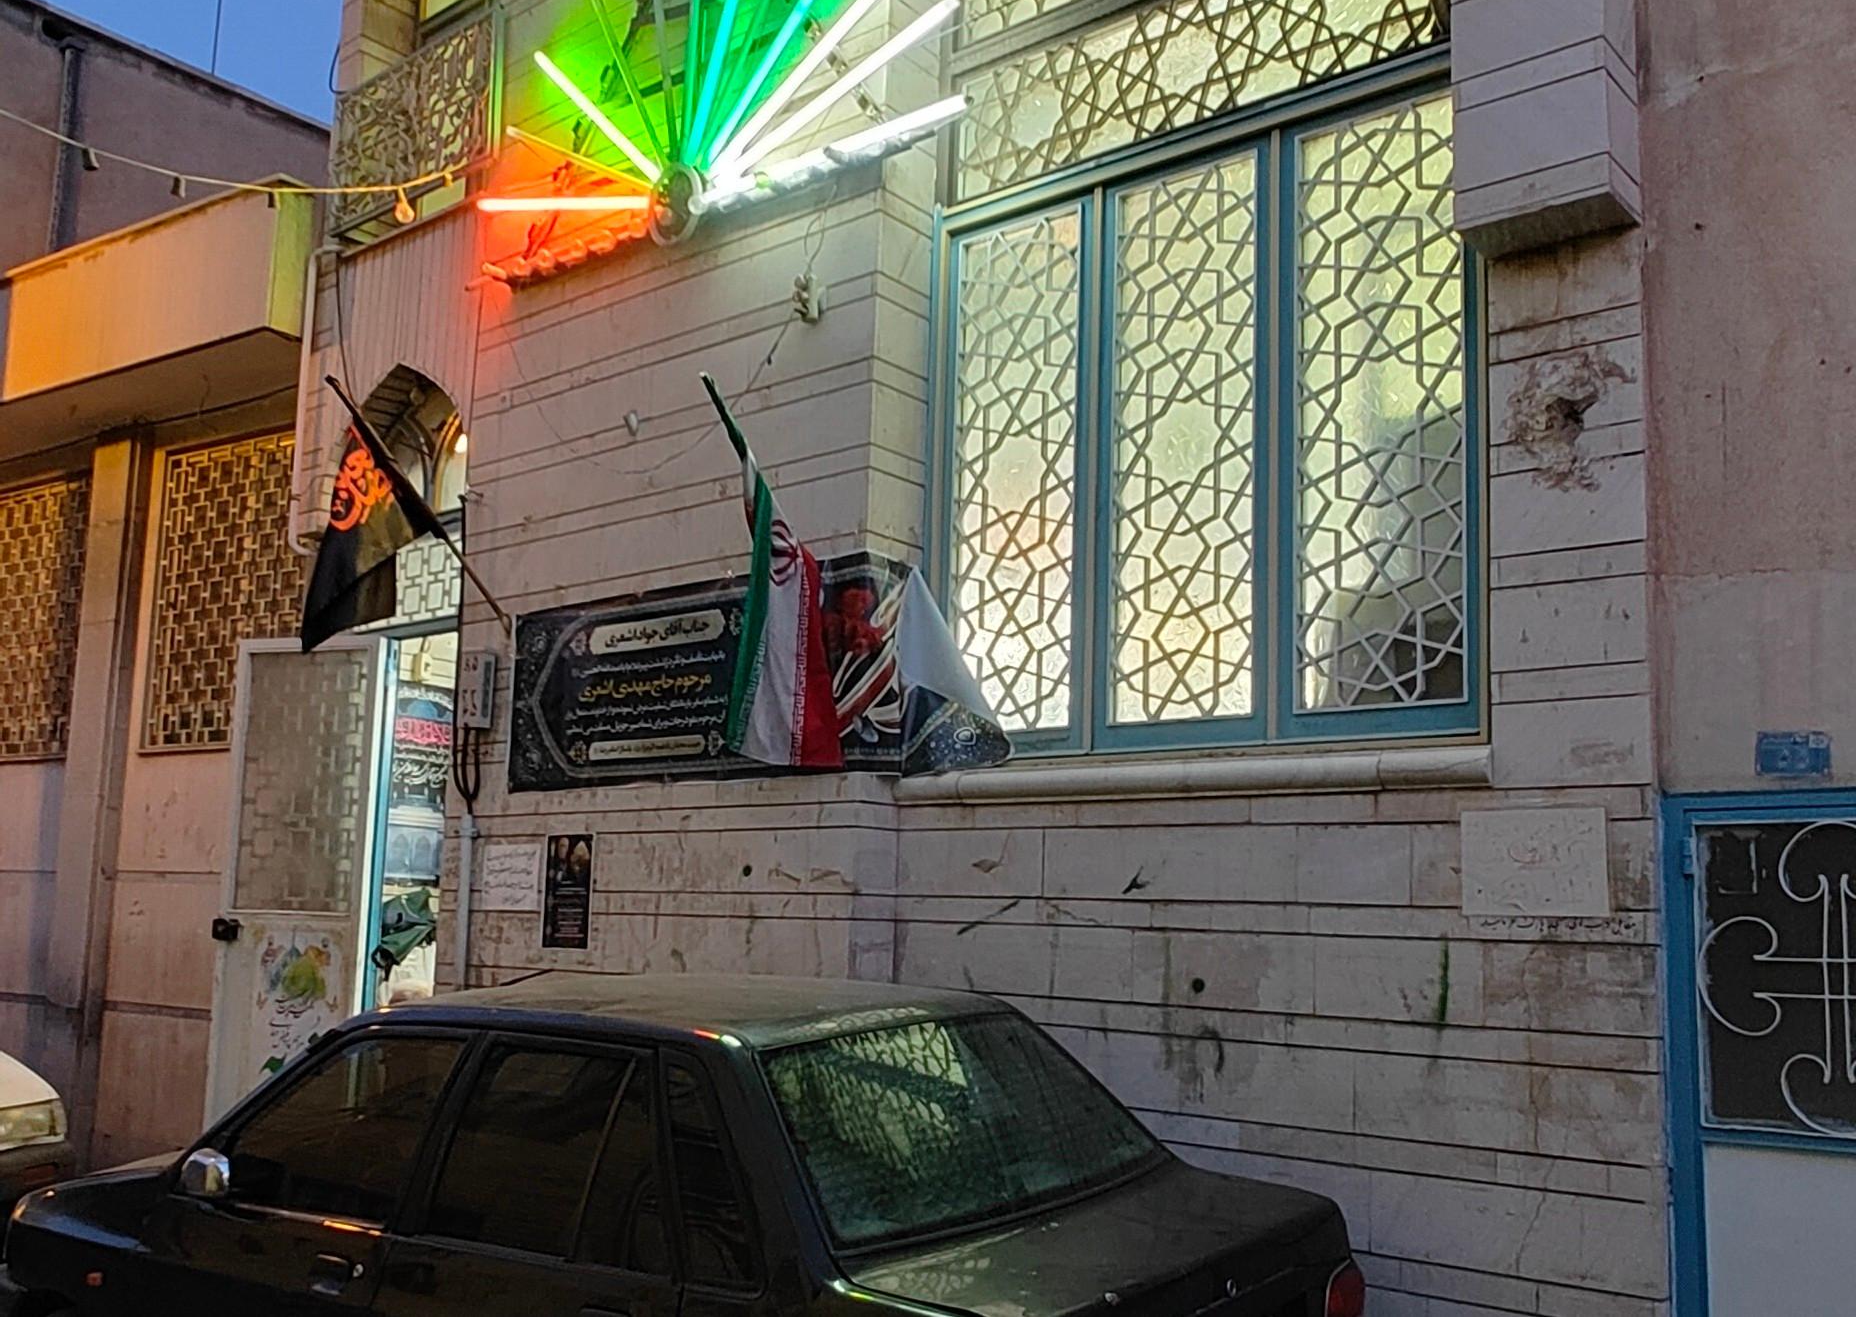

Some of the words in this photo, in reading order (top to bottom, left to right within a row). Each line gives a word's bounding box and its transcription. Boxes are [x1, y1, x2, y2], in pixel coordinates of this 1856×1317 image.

[638, 624, 659, 644] جواد
[659, 619, 682, 639] آقای
[682, 618, 709, 636] جناب
[579, 680, 613, 701] اشعری
[612, 679, 652, 698] مهدی
[650, 672, 675, 696] حاج
[675, 674, 712, 693] مرحوم
